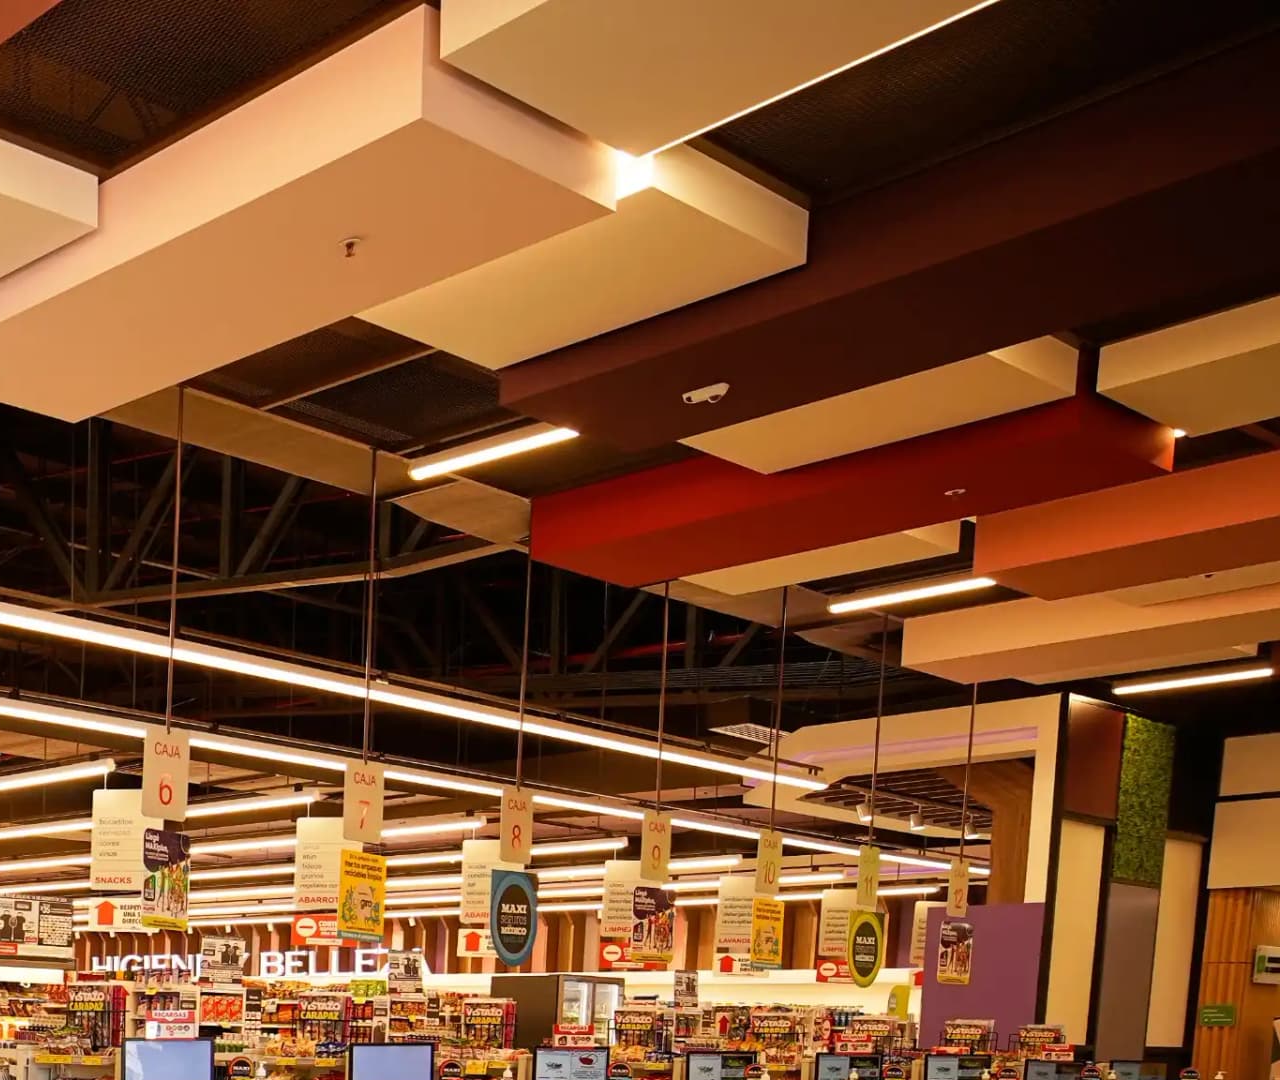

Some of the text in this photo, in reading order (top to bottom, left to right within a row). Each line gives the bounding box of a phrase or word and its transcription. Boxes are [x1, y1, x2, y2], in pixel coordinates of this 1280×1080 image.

[154, 741, 181, 759] CAJA
[354, 771, 377, 787] CAJA
[159, 774, 173, 806] 6
[508, 798, 527, 812] CAJA
[358, 801, 370, 830] 7
[511, 824, 522, 850] 8
[652, 844, 661, 870] 9
[95, 876, 132, 884] SNACKS
[764, 861, 776, 885] 10
[501, 903, 527, 914] MAXI
[856, 936, 876, 945] MAXI
[300, 1011, 339, 1021] CARAPAZ
[466, 1016, 502, 1025] CARAPAZ
